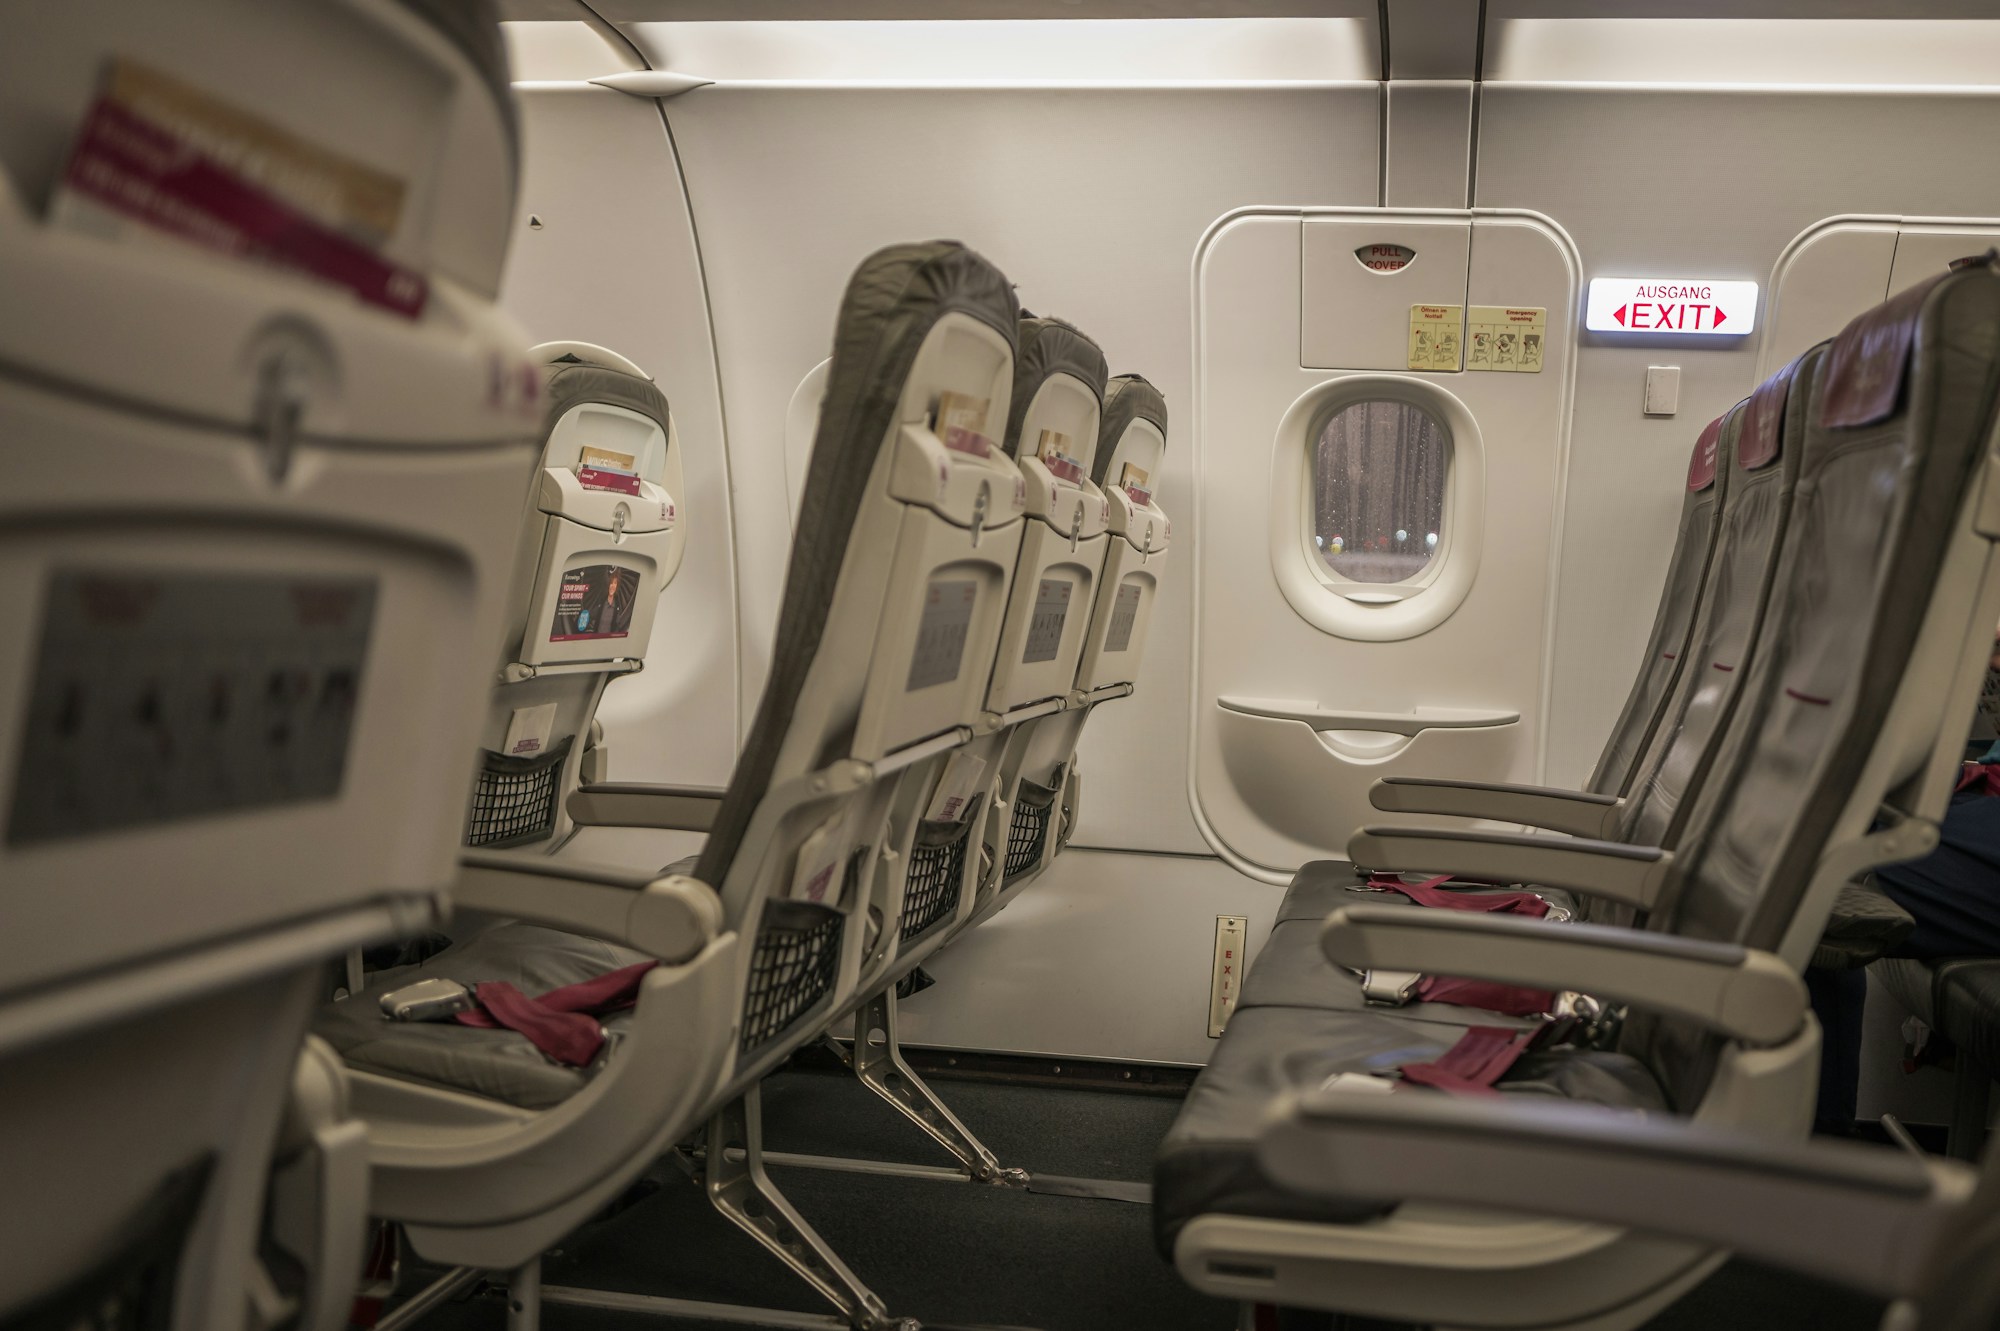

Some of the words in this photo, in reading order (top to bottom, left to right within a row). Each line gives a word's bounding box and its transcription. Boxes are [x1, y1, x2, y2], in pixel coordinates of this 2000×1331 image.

[1372, 247, 1401, 257] PULL
[1366, 260, 1406, 270] COVER
[1636, 285, 1711, 299] AUSGANG
[1631, 303, 1710, 330] EXIT
[1221, 950, 1232, 1005] EXIT
